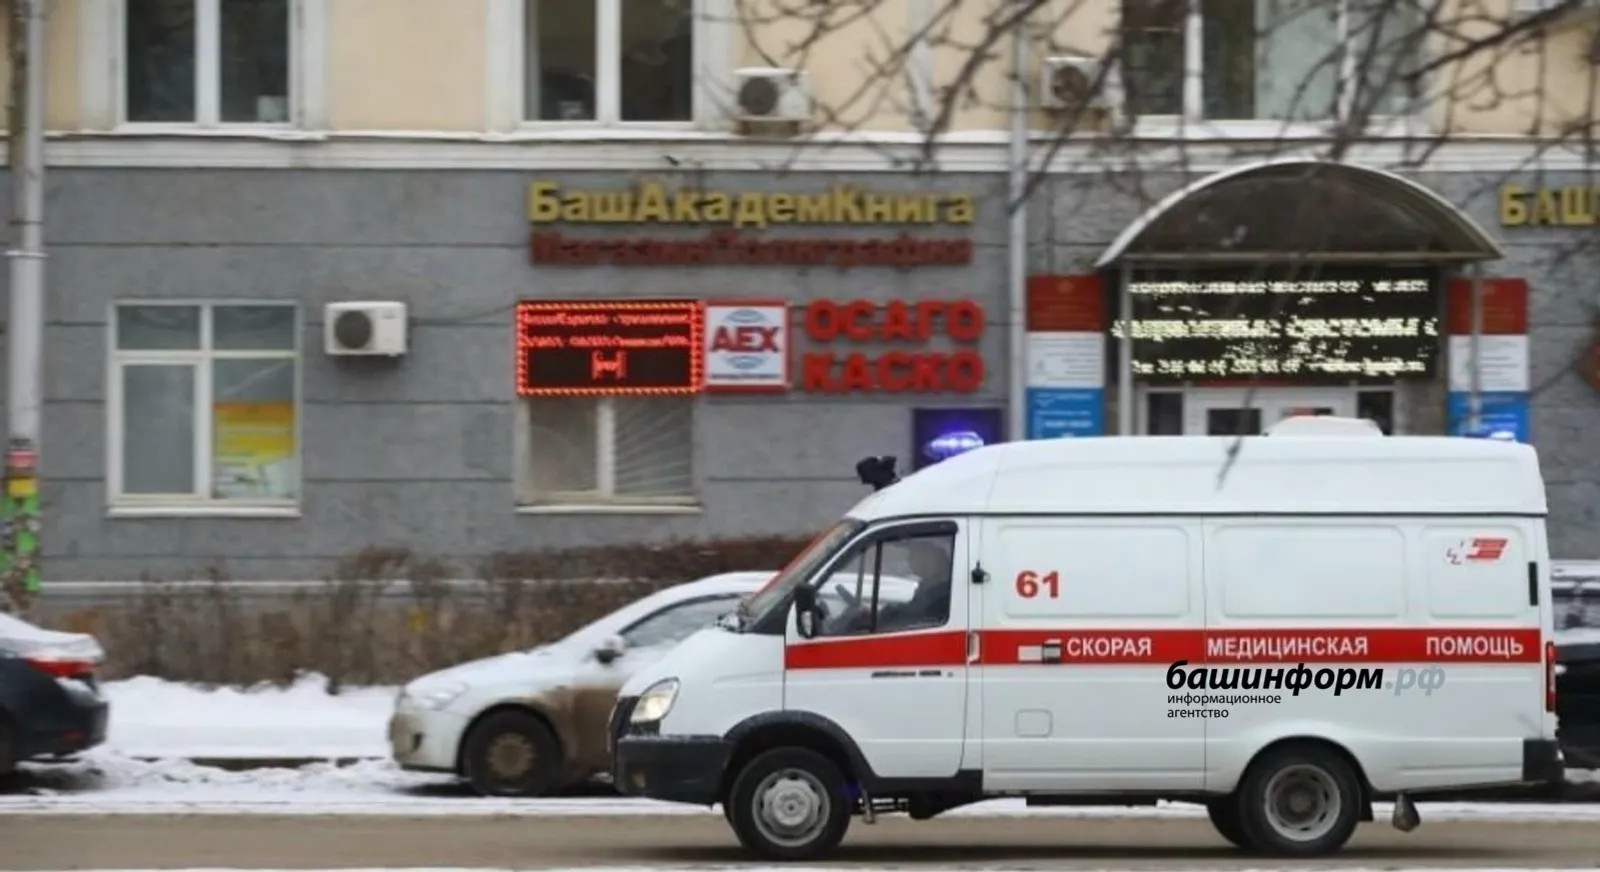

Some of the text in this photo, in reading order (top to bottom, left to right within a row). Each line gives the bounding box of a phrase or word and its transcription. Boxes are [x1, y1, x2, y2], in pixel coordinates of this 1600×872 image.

[527, 181, 975, 228] БашАкадемКнига
[803, 298, 985, 344] ОСАГО
[802, 351, 985, 393] КАСКО
[1015, 570, 1060, 599] 61
[1066, 636, 1524, 660] СКОРАЯ МЕДИЦИНСКАЯ ПОМОЩЬ
